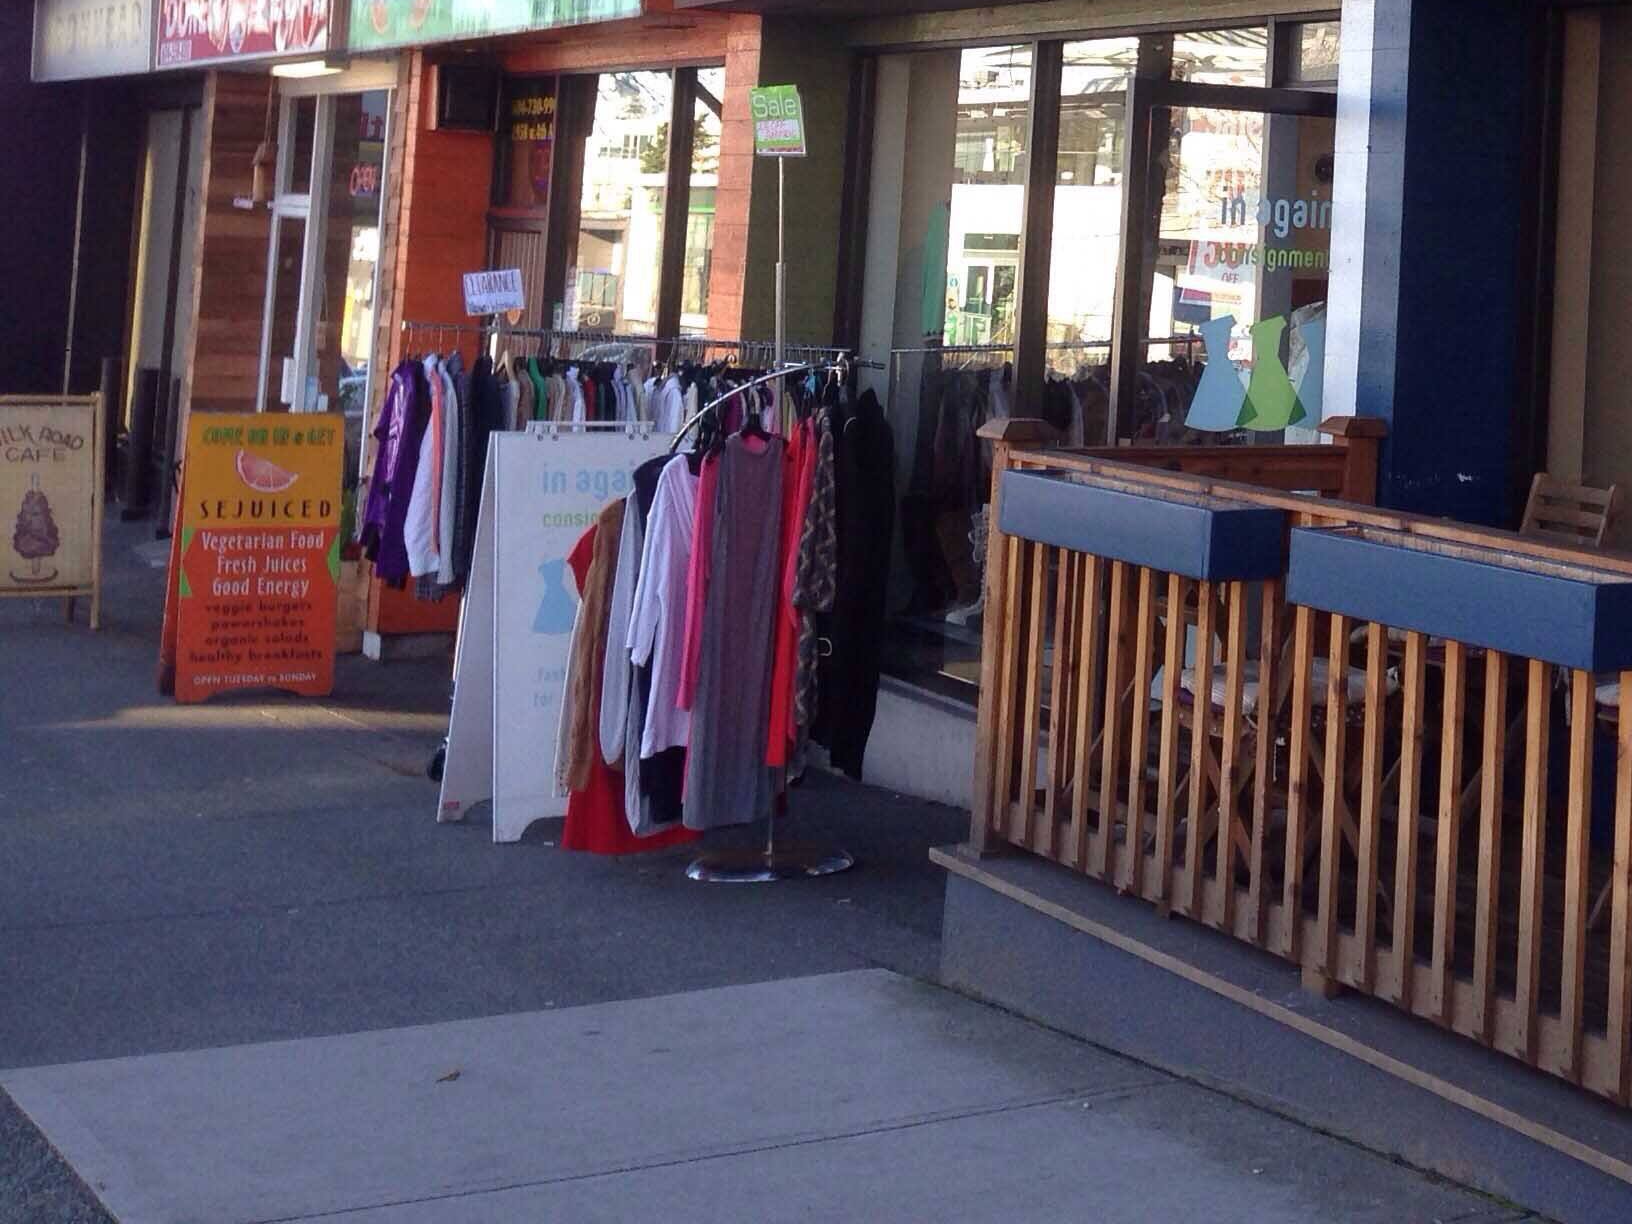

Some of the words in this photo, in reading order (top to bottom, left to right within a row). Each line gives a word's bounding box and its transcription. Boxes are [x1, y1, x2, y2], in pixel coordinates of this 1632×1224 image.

[752, 91, 797, 118] Sale
[0, 423, 39, 446] ILK
[543, 461, 567, 494] in
[575, 460, 636, 501] agai
[200, 499, 332, 519] SEJUICED
[202, 531, 284, 553] Vegetarian
[290, 529, 325, 550] Food
[217, 554, 257, 575] Fresh
[263, 554, 307, 574] Juices
[212, 577, 250, 597] Good
[257, 576, 310, 599] Energy
[258, 599, 312, 614] burgers
[205, 634, 257, 648] organic
[265, 632, 309, 644] salads
[190, 649, 241, 664] healthy
